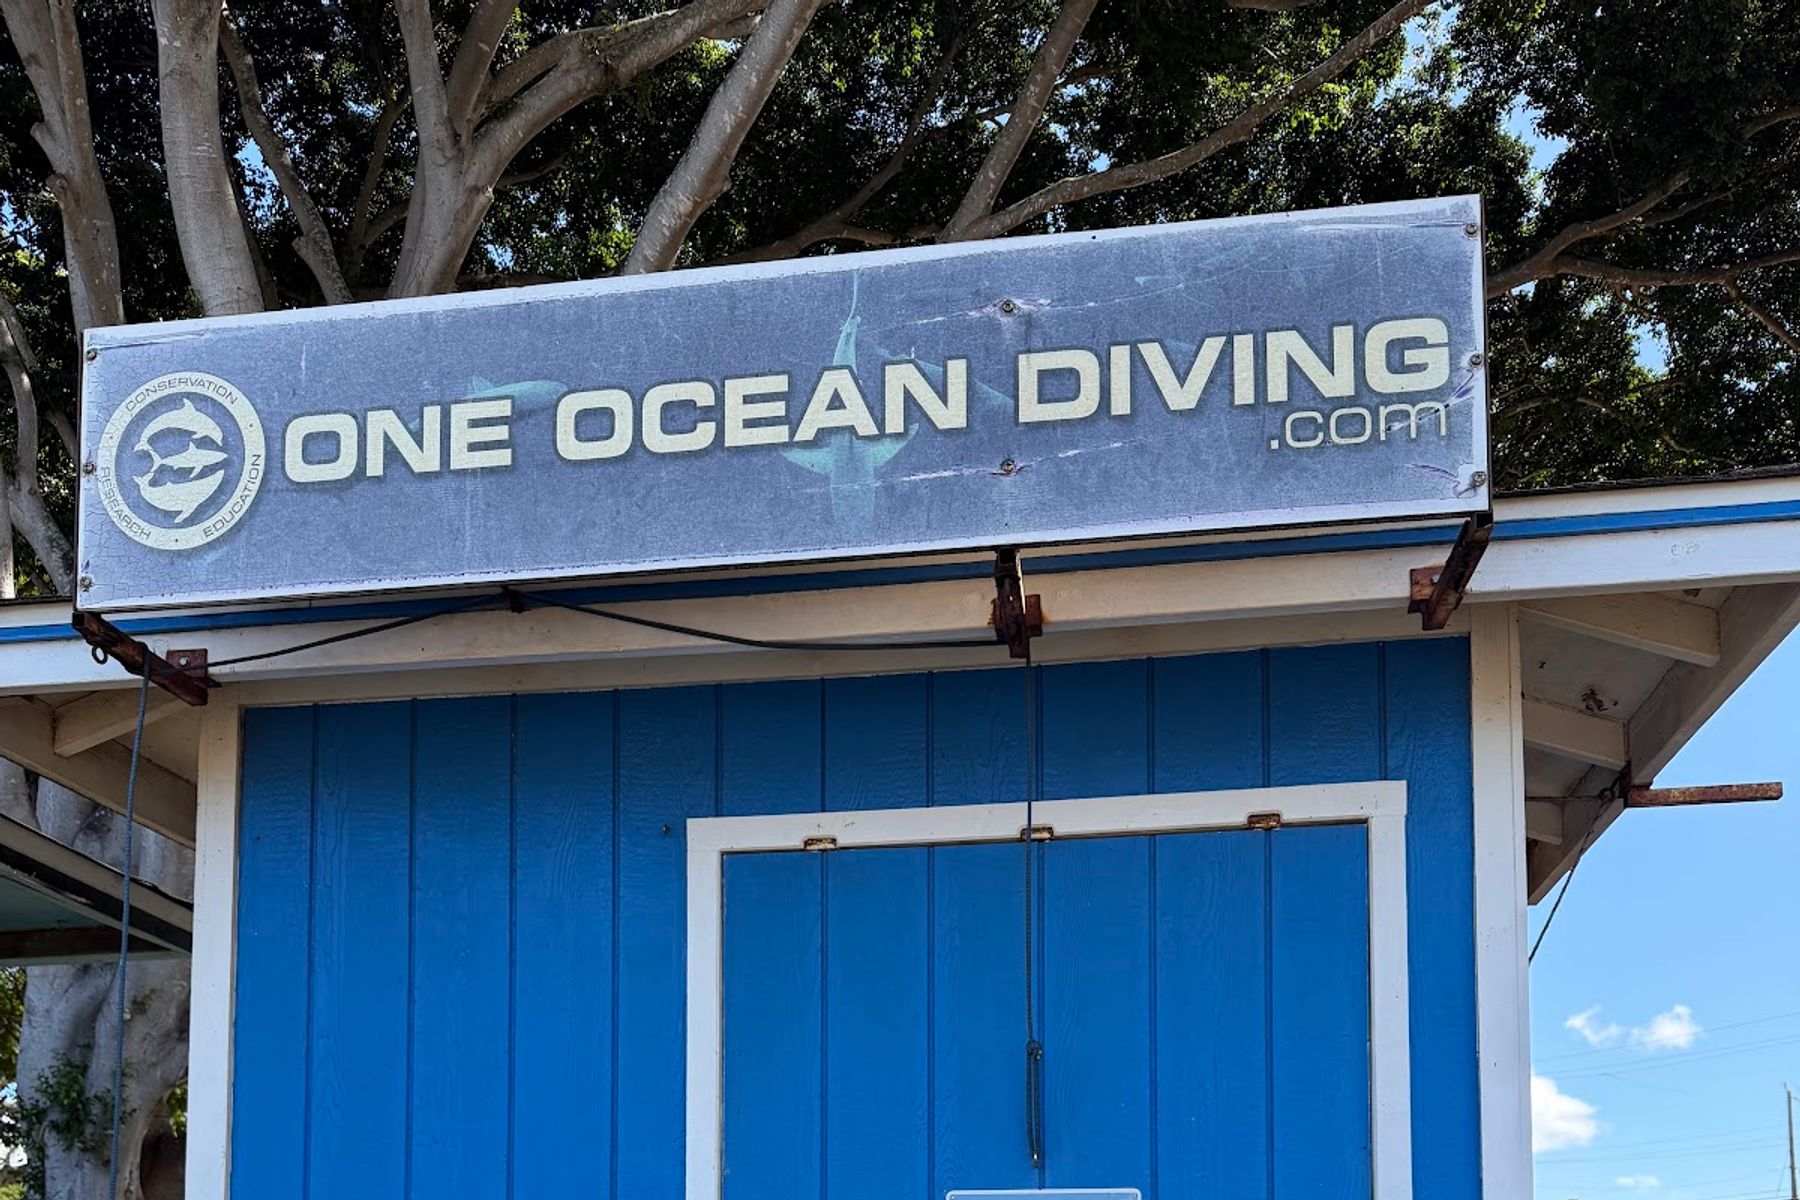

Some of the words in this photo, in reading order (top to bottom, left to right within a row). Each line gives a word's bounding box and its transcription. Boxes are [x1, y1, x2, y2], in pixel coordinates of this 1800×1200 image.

[125, 377, 239, 411] CONSERVATION
[283, 398, 513, 484] ONE
[555, 357, 968, 463] OCEAN
[1017, 317, 1451, 423] DIVING
[1269, 400, 1448, 450] .com
[100, 466, 151, 540] RESEARCH
[202, 453, 262, 539] EDUCATION
